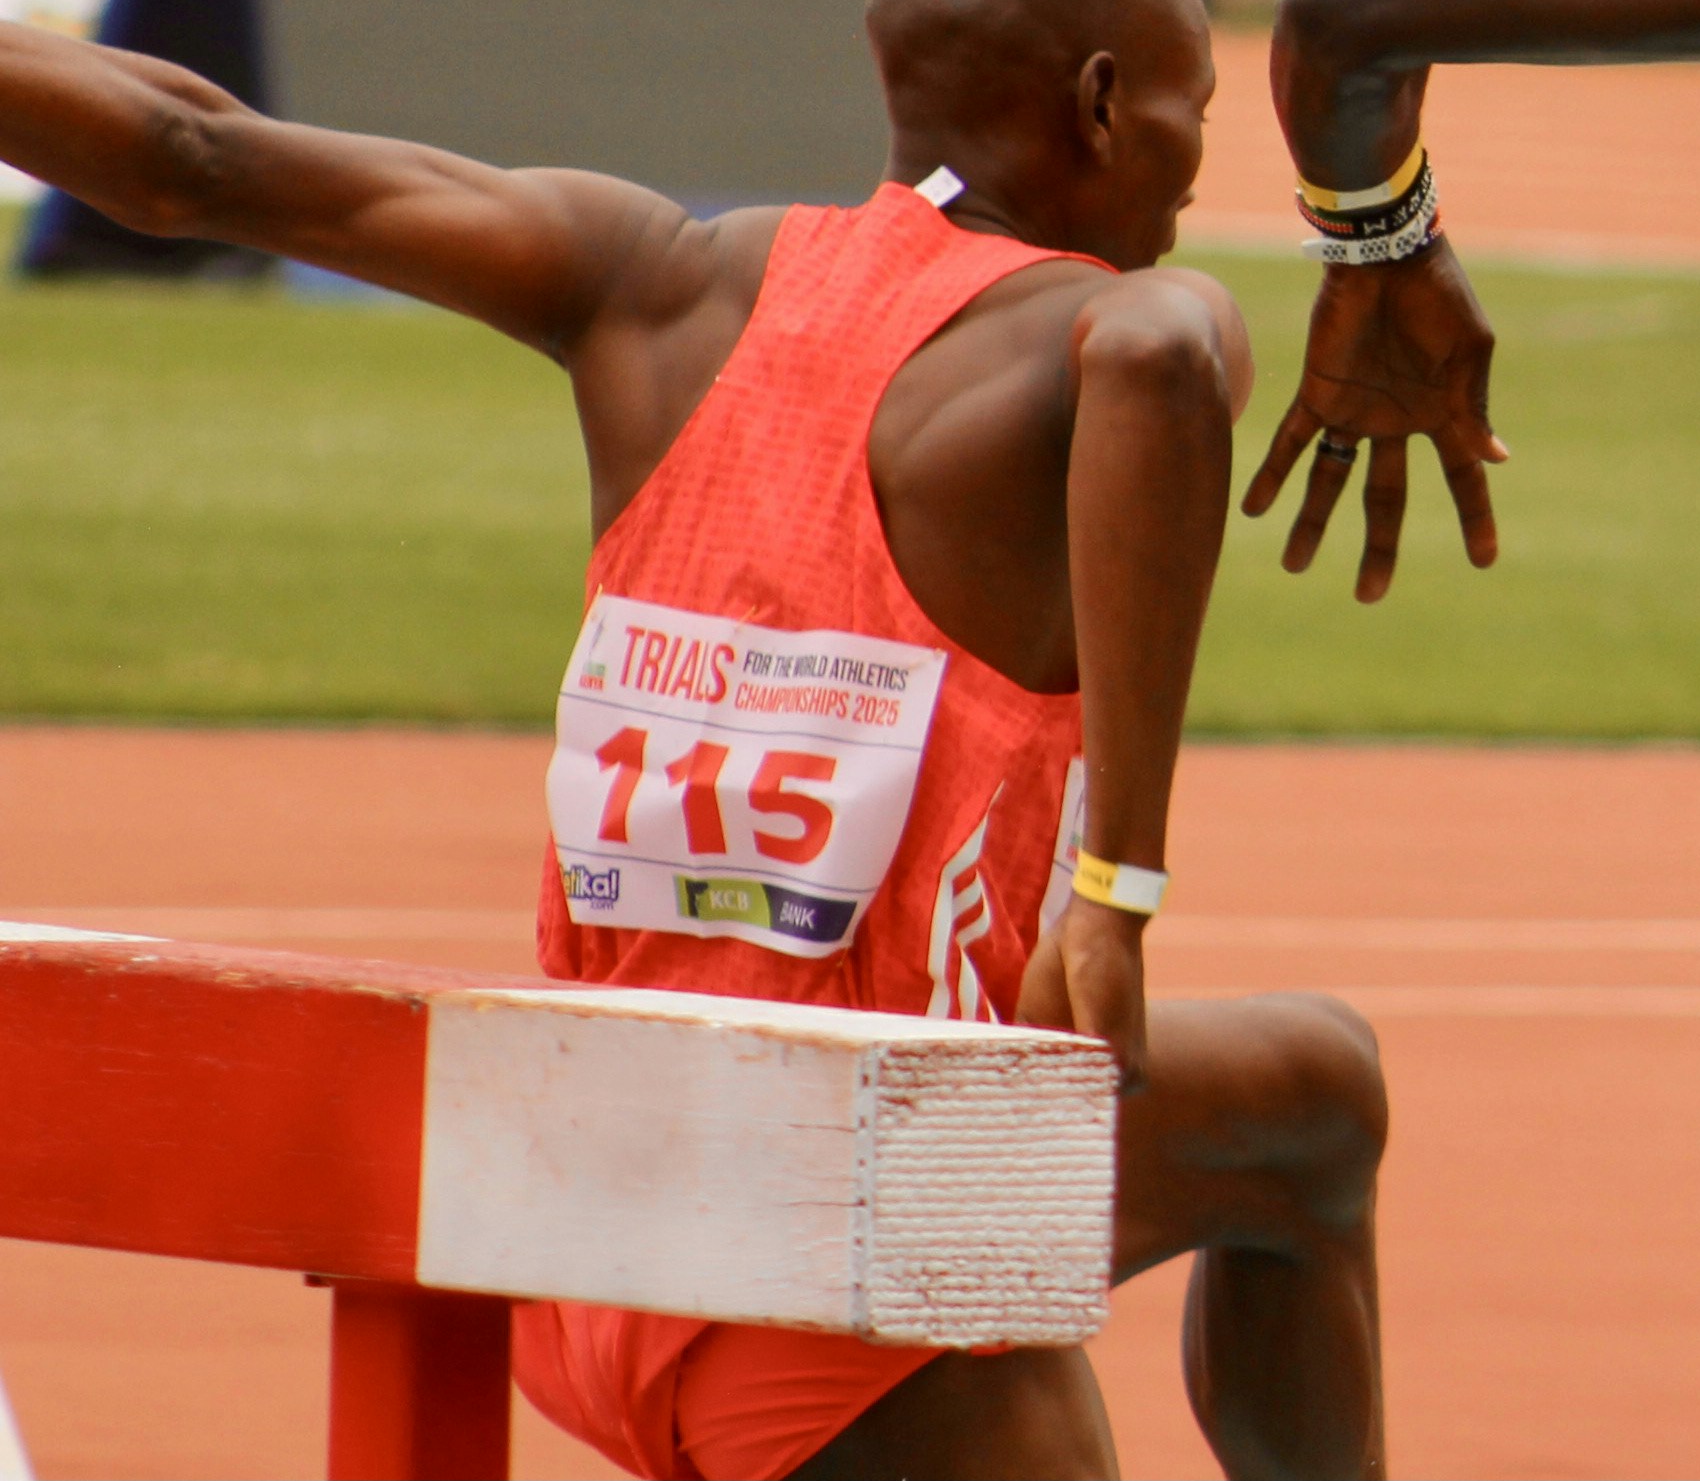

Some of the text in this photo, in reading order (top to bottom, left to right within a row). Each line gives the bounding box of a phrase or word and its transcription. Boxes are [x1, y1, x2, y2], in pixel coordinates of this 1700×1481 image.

[619, 625, 736, 706] TRIALS
[743, 649, 910, 692] FOR THE WORLD ATHLETICS
[734, 681, 900, 726] CHAMPIONSHIPS 2025
[595, 726, 838, 867] 115
[708, 890, 750, 911] KCB
[779, 901, 815, 931] BANK
